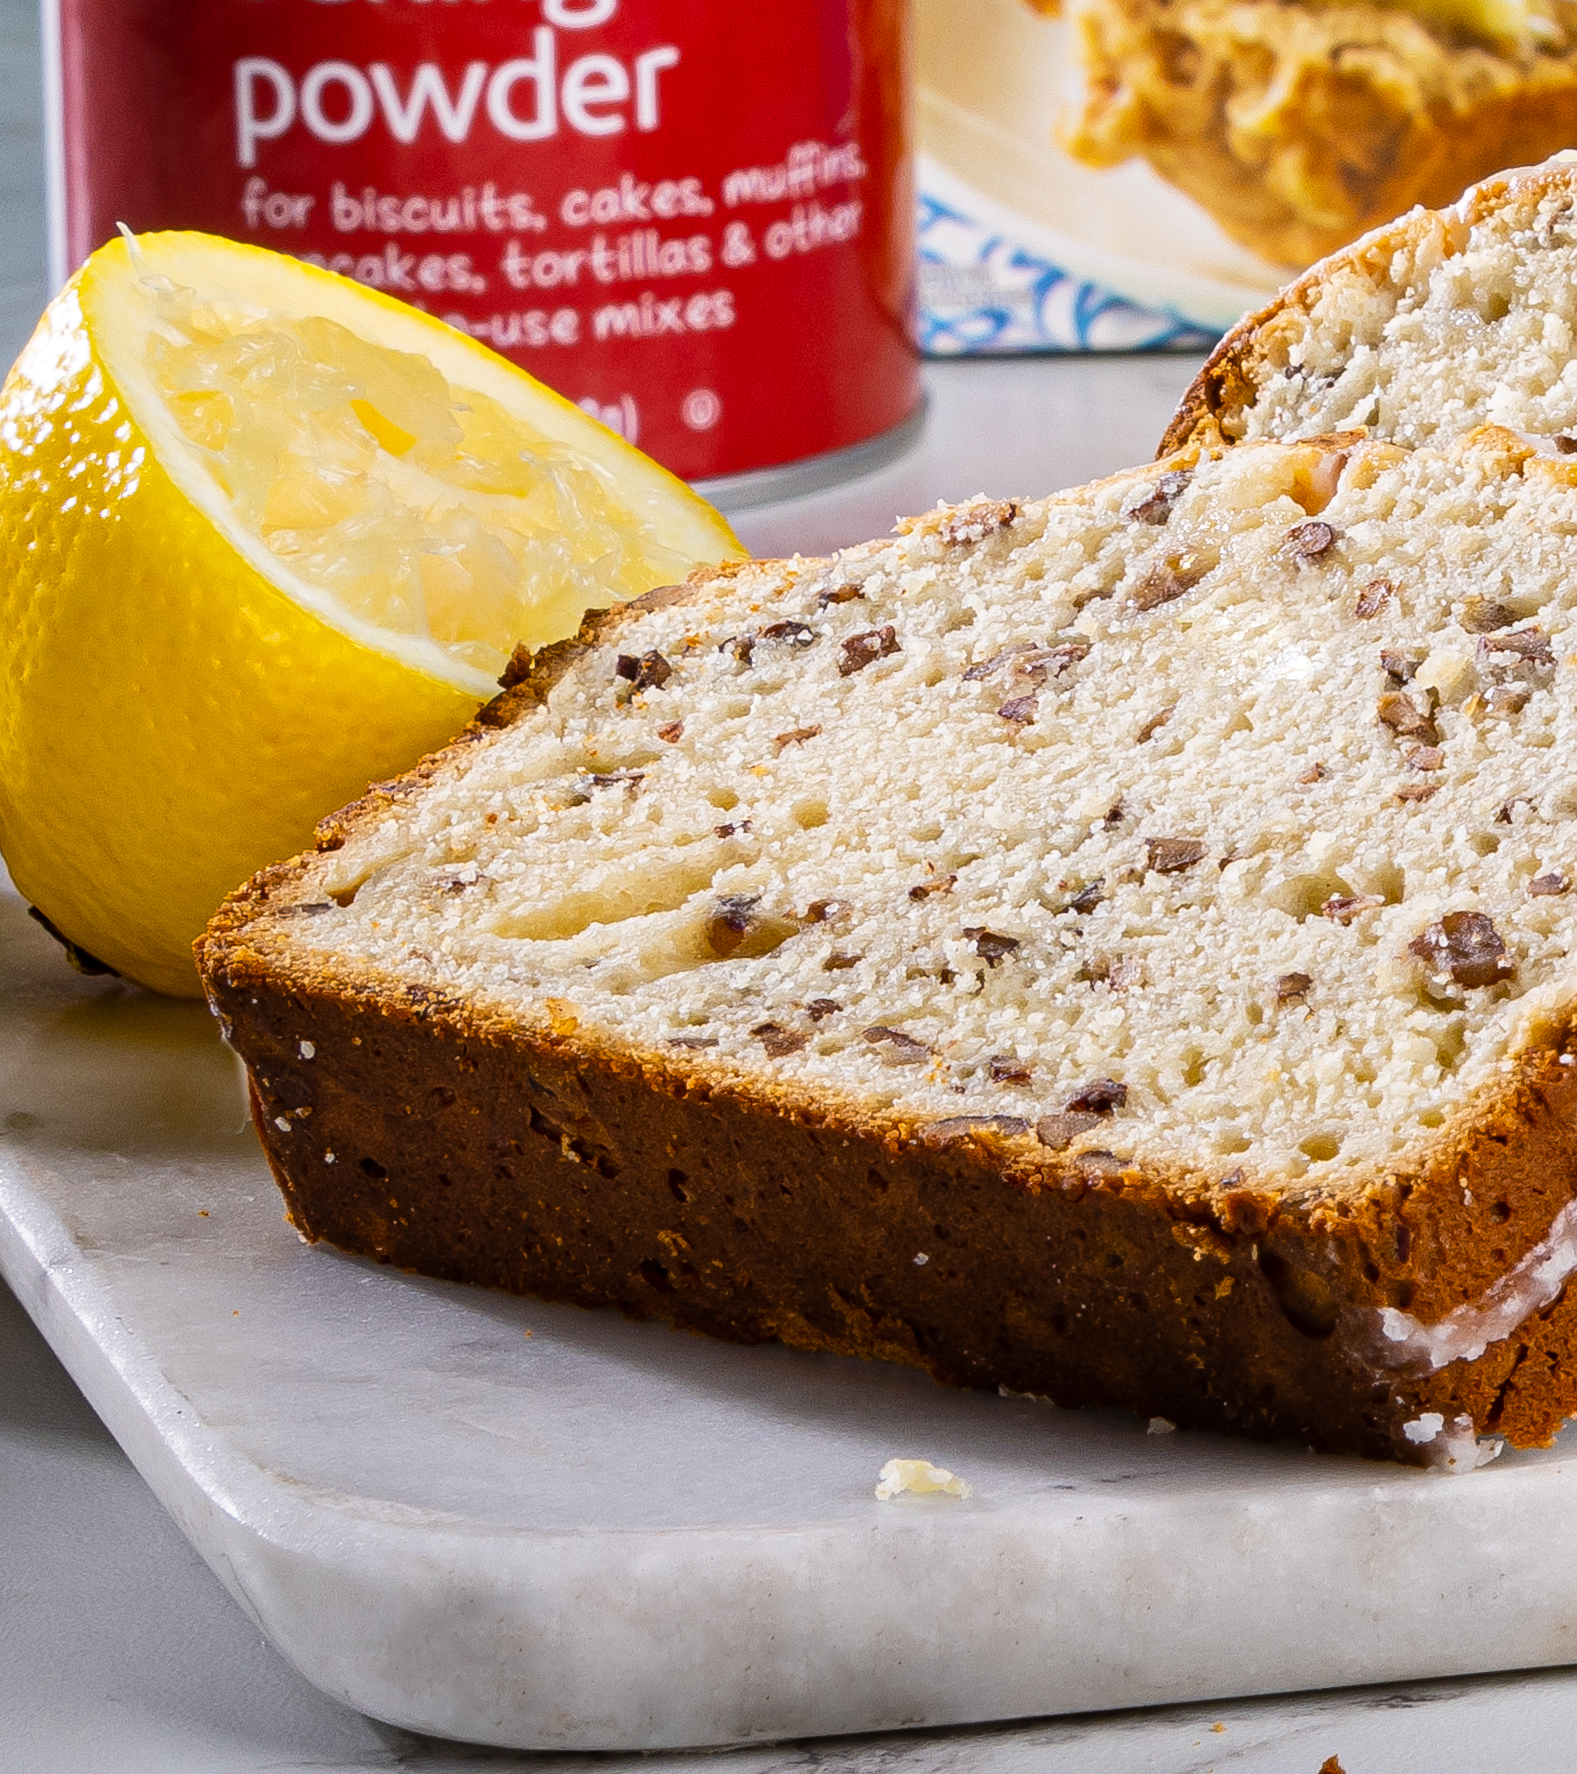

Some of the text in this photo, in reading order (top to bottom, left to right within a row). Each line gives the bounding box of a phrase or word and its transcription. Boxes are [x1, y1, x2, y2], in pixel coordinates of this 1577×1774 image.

[235, 27, 681, 168] powder
[240, 176, 316, 230] for
[328, 180, 548, 234] biscuits,
[559, 171, 716, 228] cakes,
[500, 227, 714, 289] tortillas
[720, 219, 758, 269] &
[763, 199, 864, 261] other
[591, 288, 738, 340] mixes
